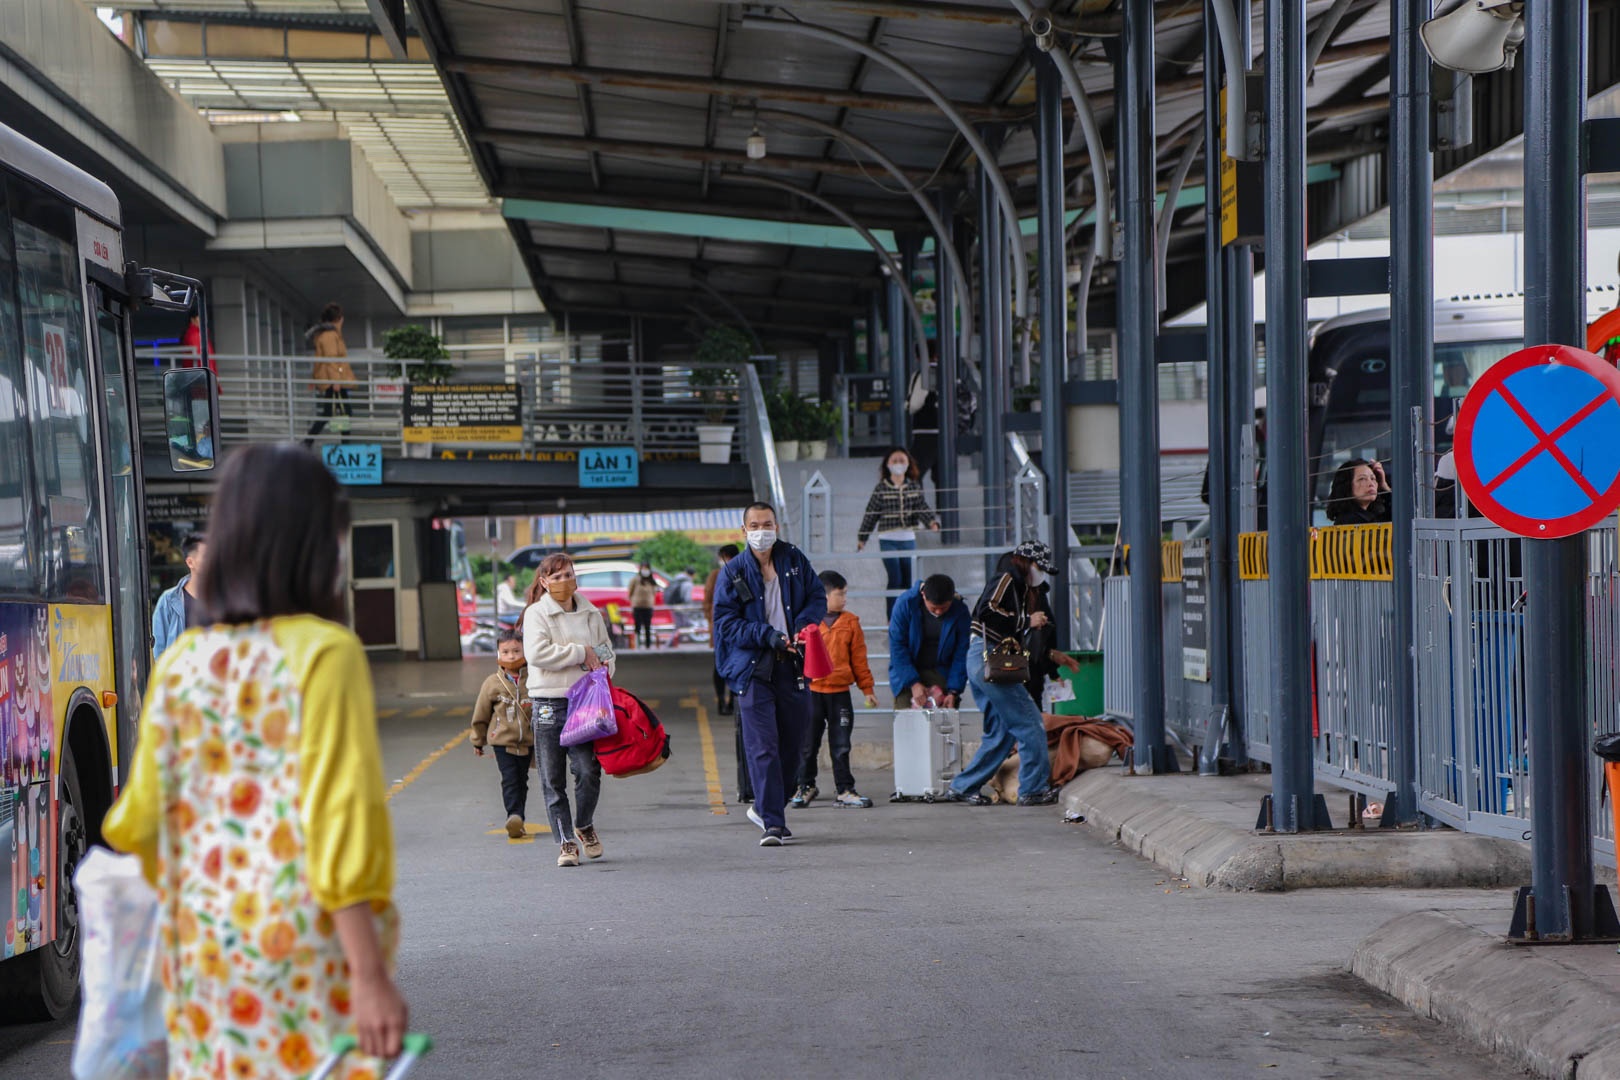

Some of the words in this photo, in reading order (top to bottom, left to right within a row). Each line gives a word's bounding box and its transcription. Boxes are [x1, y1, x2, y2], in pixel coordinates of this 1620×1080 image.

[568, 423, 595, 441] XE
[327, 449, 360, 466] LÀN
[367, 453, 376, 466] 2
[584, 452, 618, 470] LÀN
[625, 456, 632, 469] 1
[591, 475, 603, 483] 1st
[605, 475, 627, 483] Lane
